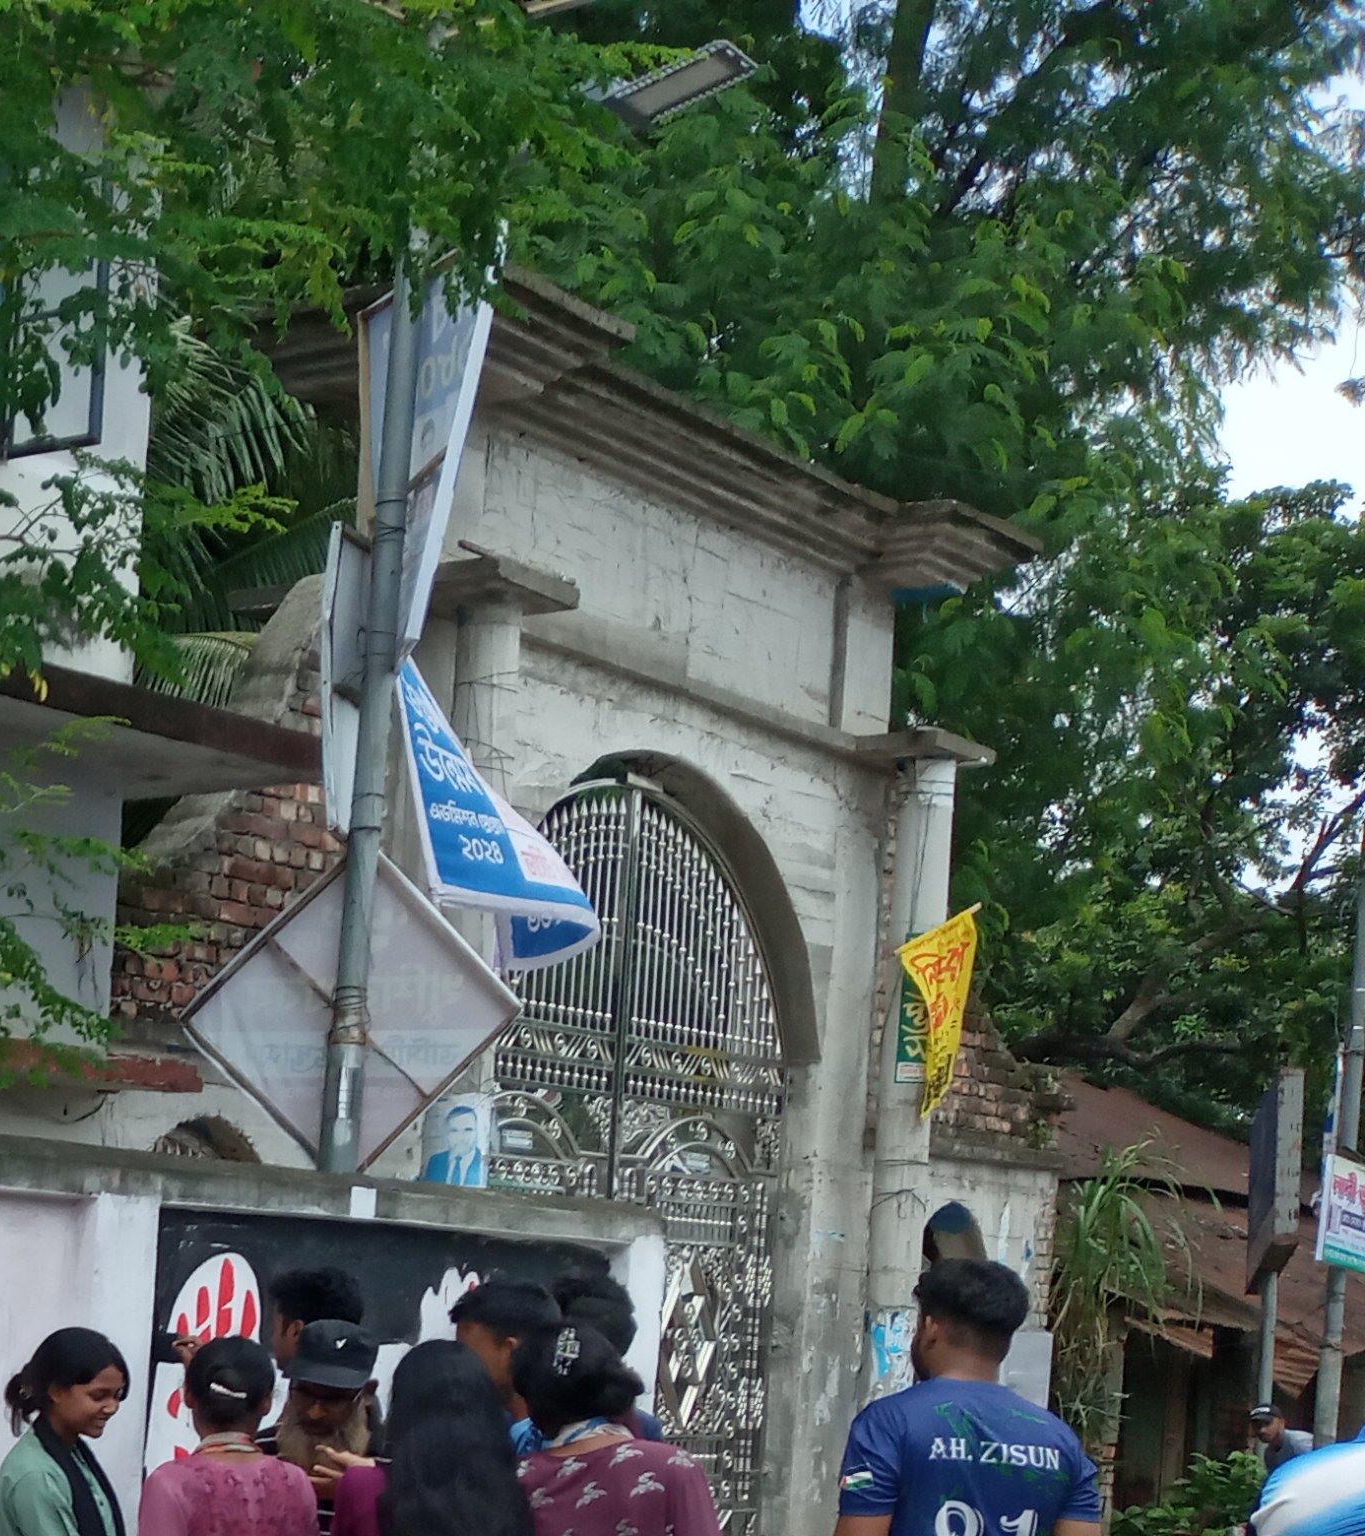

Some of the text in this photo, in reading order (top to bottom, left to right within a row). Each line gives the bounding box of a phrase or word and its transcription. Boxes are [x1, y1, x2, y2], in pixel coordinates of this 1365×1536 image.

[459, 835, 505, 864] ২০২৪
[928, 1437, 1060, 1471] AH. ZISUN
